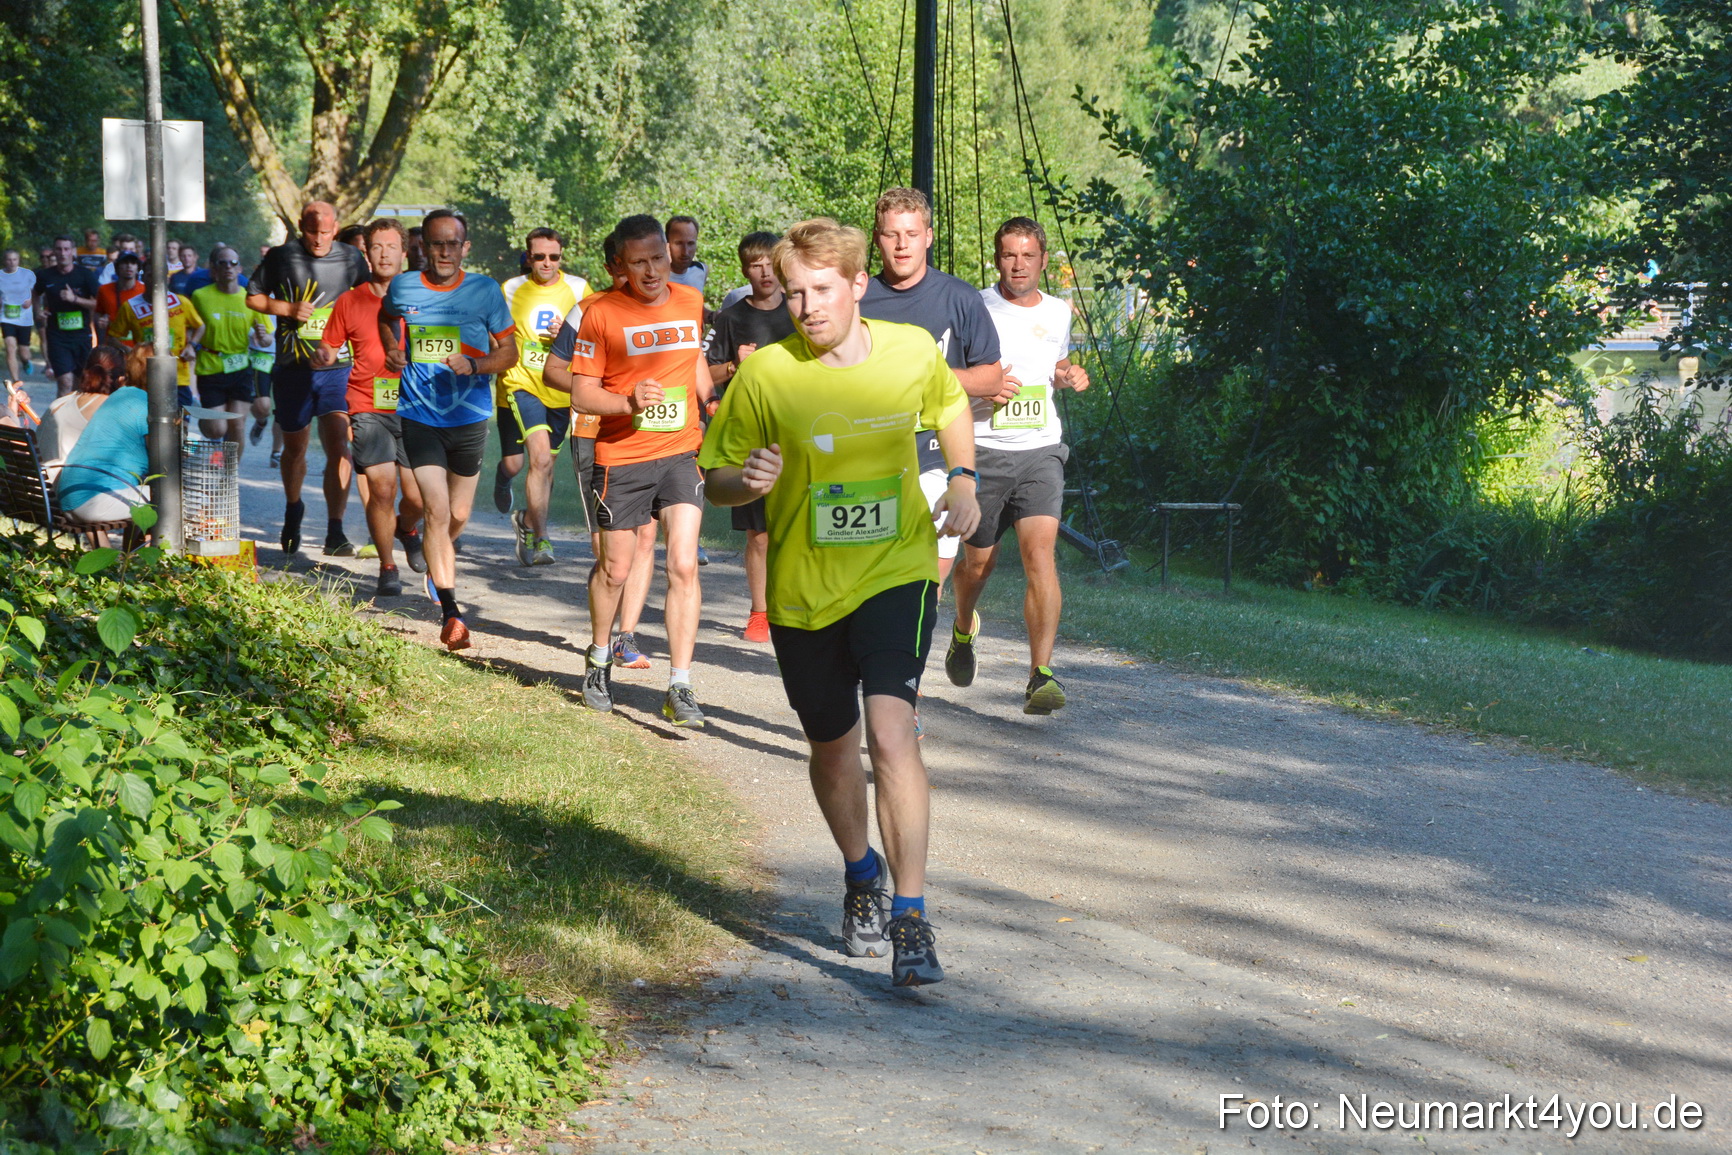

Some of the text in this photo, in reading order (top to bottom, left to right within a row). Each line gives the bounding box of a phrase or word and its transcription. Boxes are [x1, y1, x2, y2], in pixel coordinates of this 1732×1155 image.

[535, 310, 555, 330] B
[416, 338, 454, 353] 1579
[632, 326, 696, 349] OBI
[529, 351, 545, 363] 24
[382, 389, 399, 401] 45
[645, 403, 678, 420] 893
[1005, 400, 1041, 417] 1010
[832, 503, 881, 529] 921
[855, 526, 889, 536] Alexander
